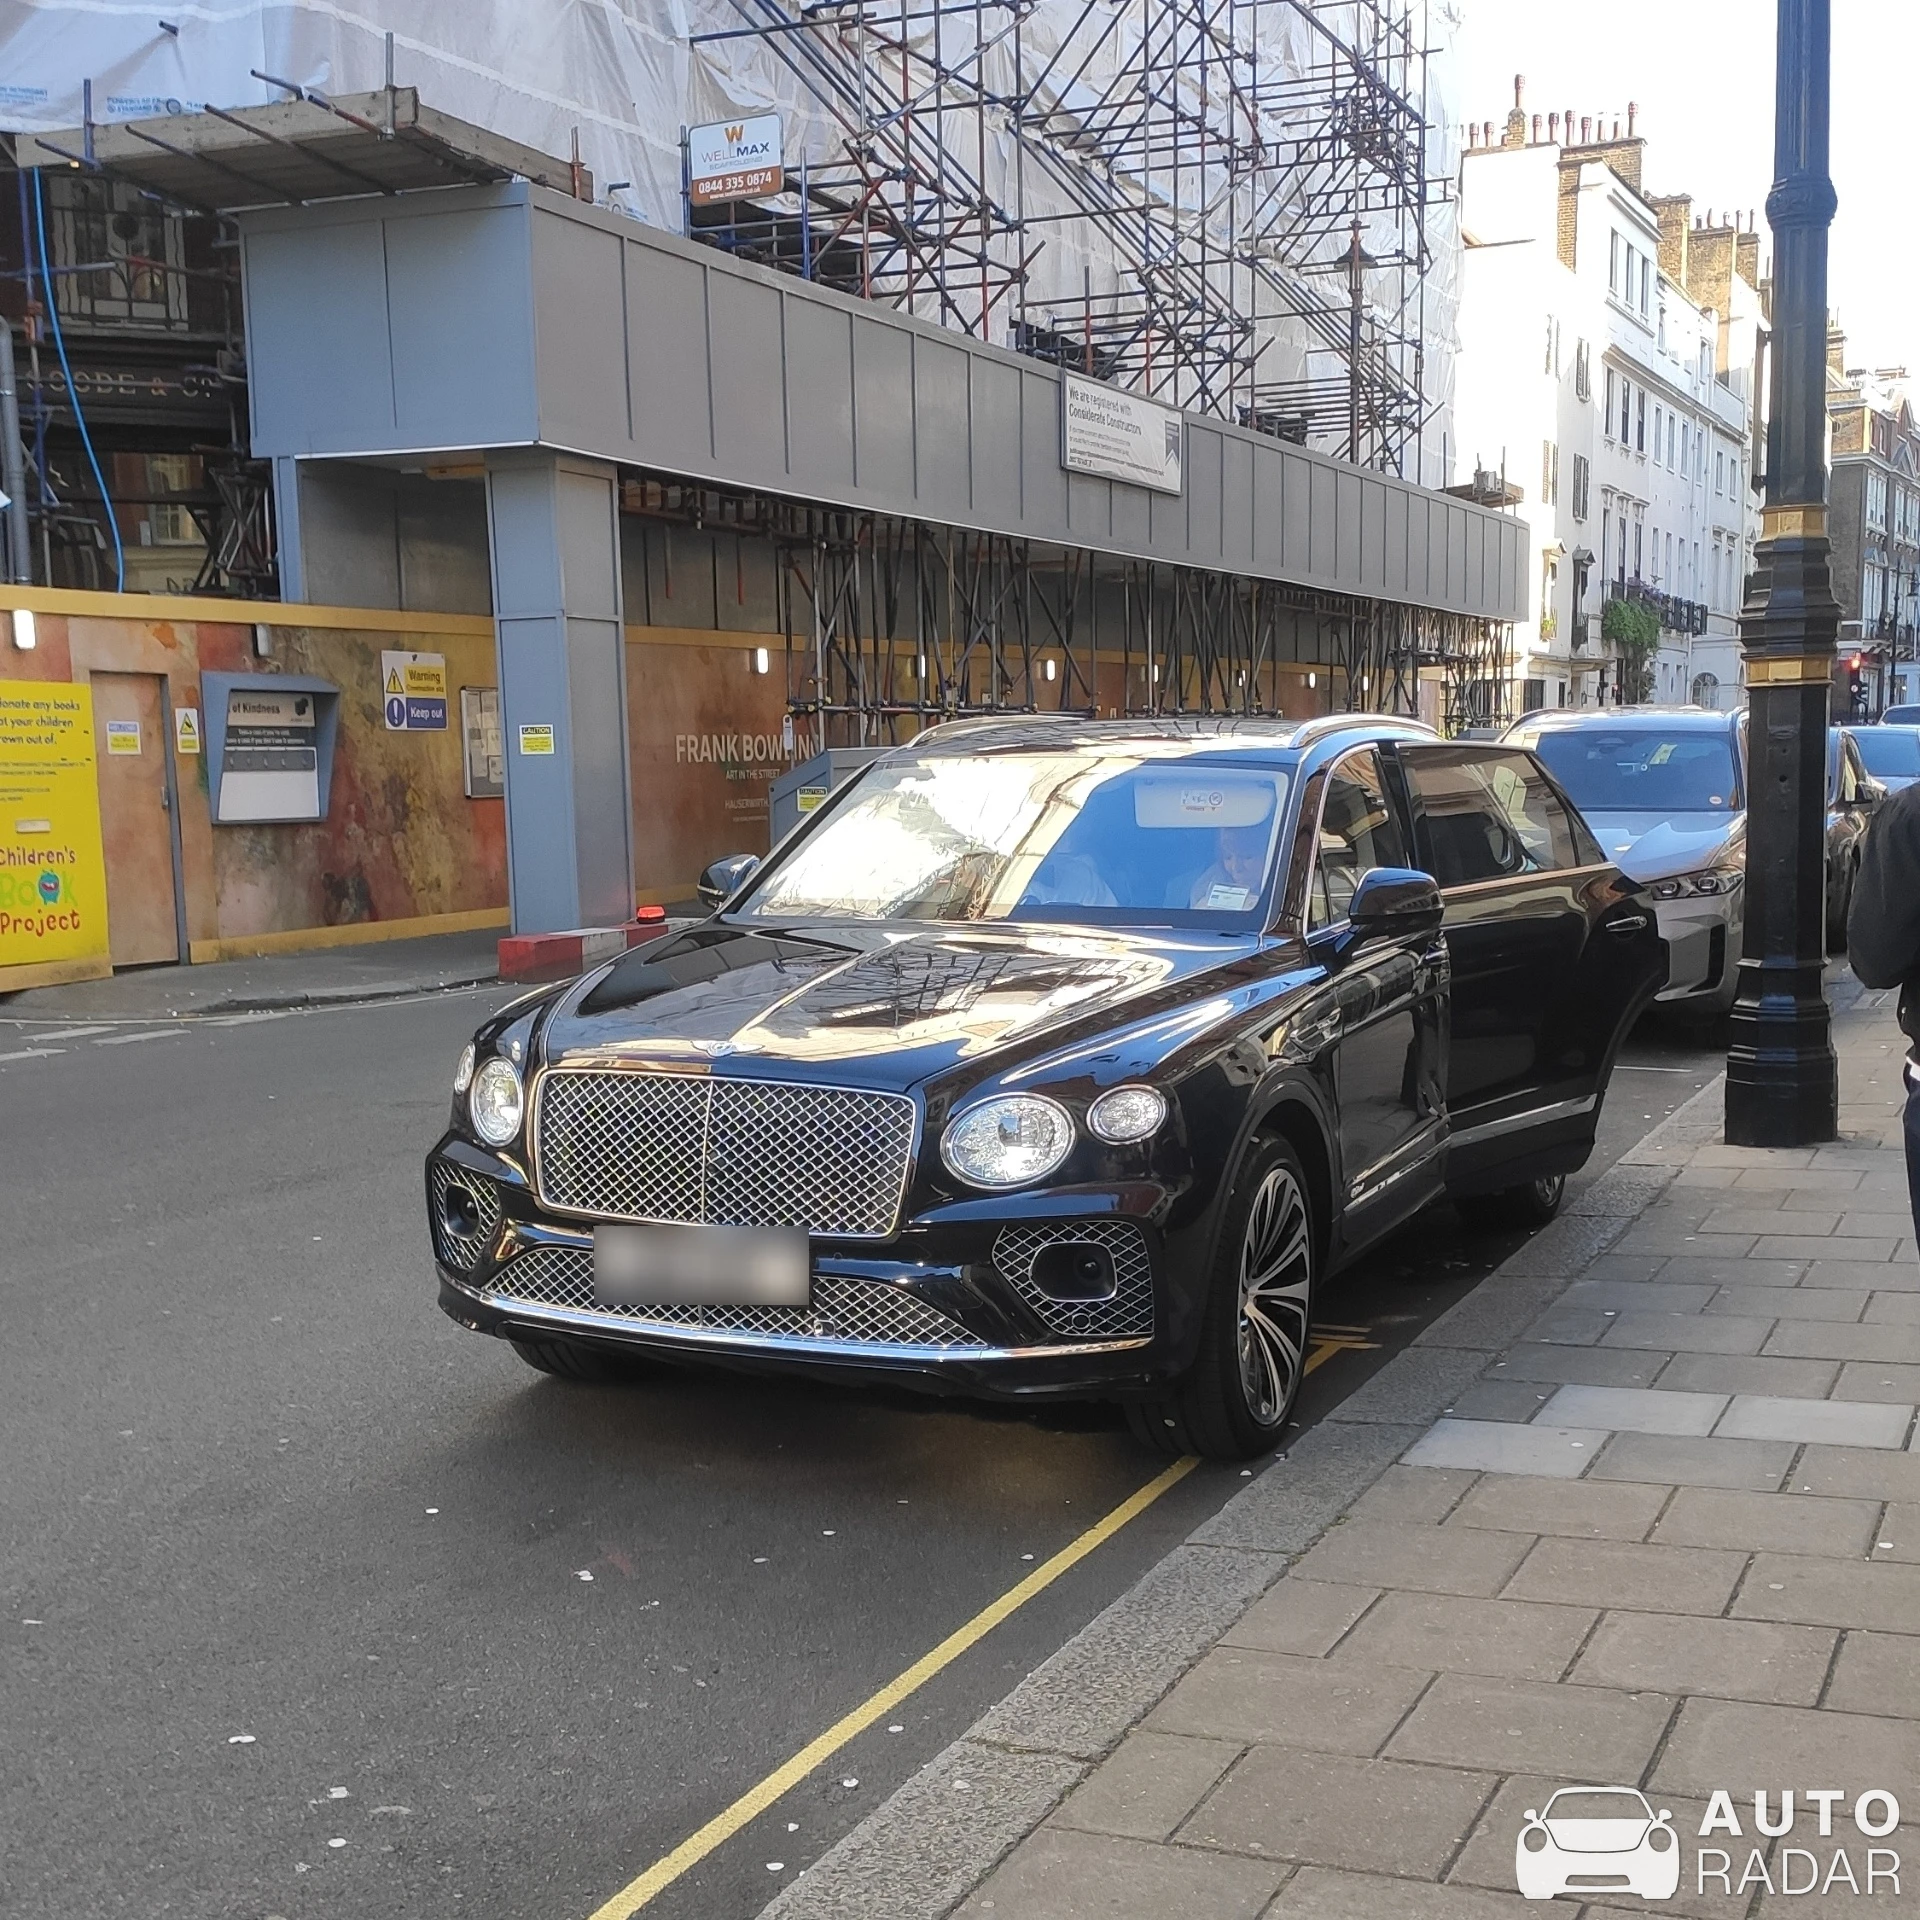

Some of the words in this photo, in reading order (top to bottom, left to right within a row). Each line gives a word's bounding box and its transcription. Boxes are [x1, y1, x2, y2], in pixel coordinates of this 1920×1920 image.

[701, 142, 770, 163] WELLMAX
[698, 178, 723, 195] 0844
[746, 170, 772, 187] 0874
[1069, 385, 1079, 401] We
[1080, 391, 1090, 404] are
[1091, 395, 1119, 413] registered
[1069, 403, 1106, 426] Considerate
[408, 669, 441, 684] Warning
[33, 701, 51, 713] any
[53, 698, 81, 711] books
[243, 704, 281, 715] Kindness
[410, 706, 430, 721] Keep
[431, 708, 444, 719] out
[10, 718, 33, 730] your
[36, 714, 74, 728] children
[26, 734, 42, 745] out
[675, 733, 740, 764] FRANK
[726, 769, 738, 780] ART
[759, 768, 780, 779] STREET
[0, 909, 80, 937] Project
